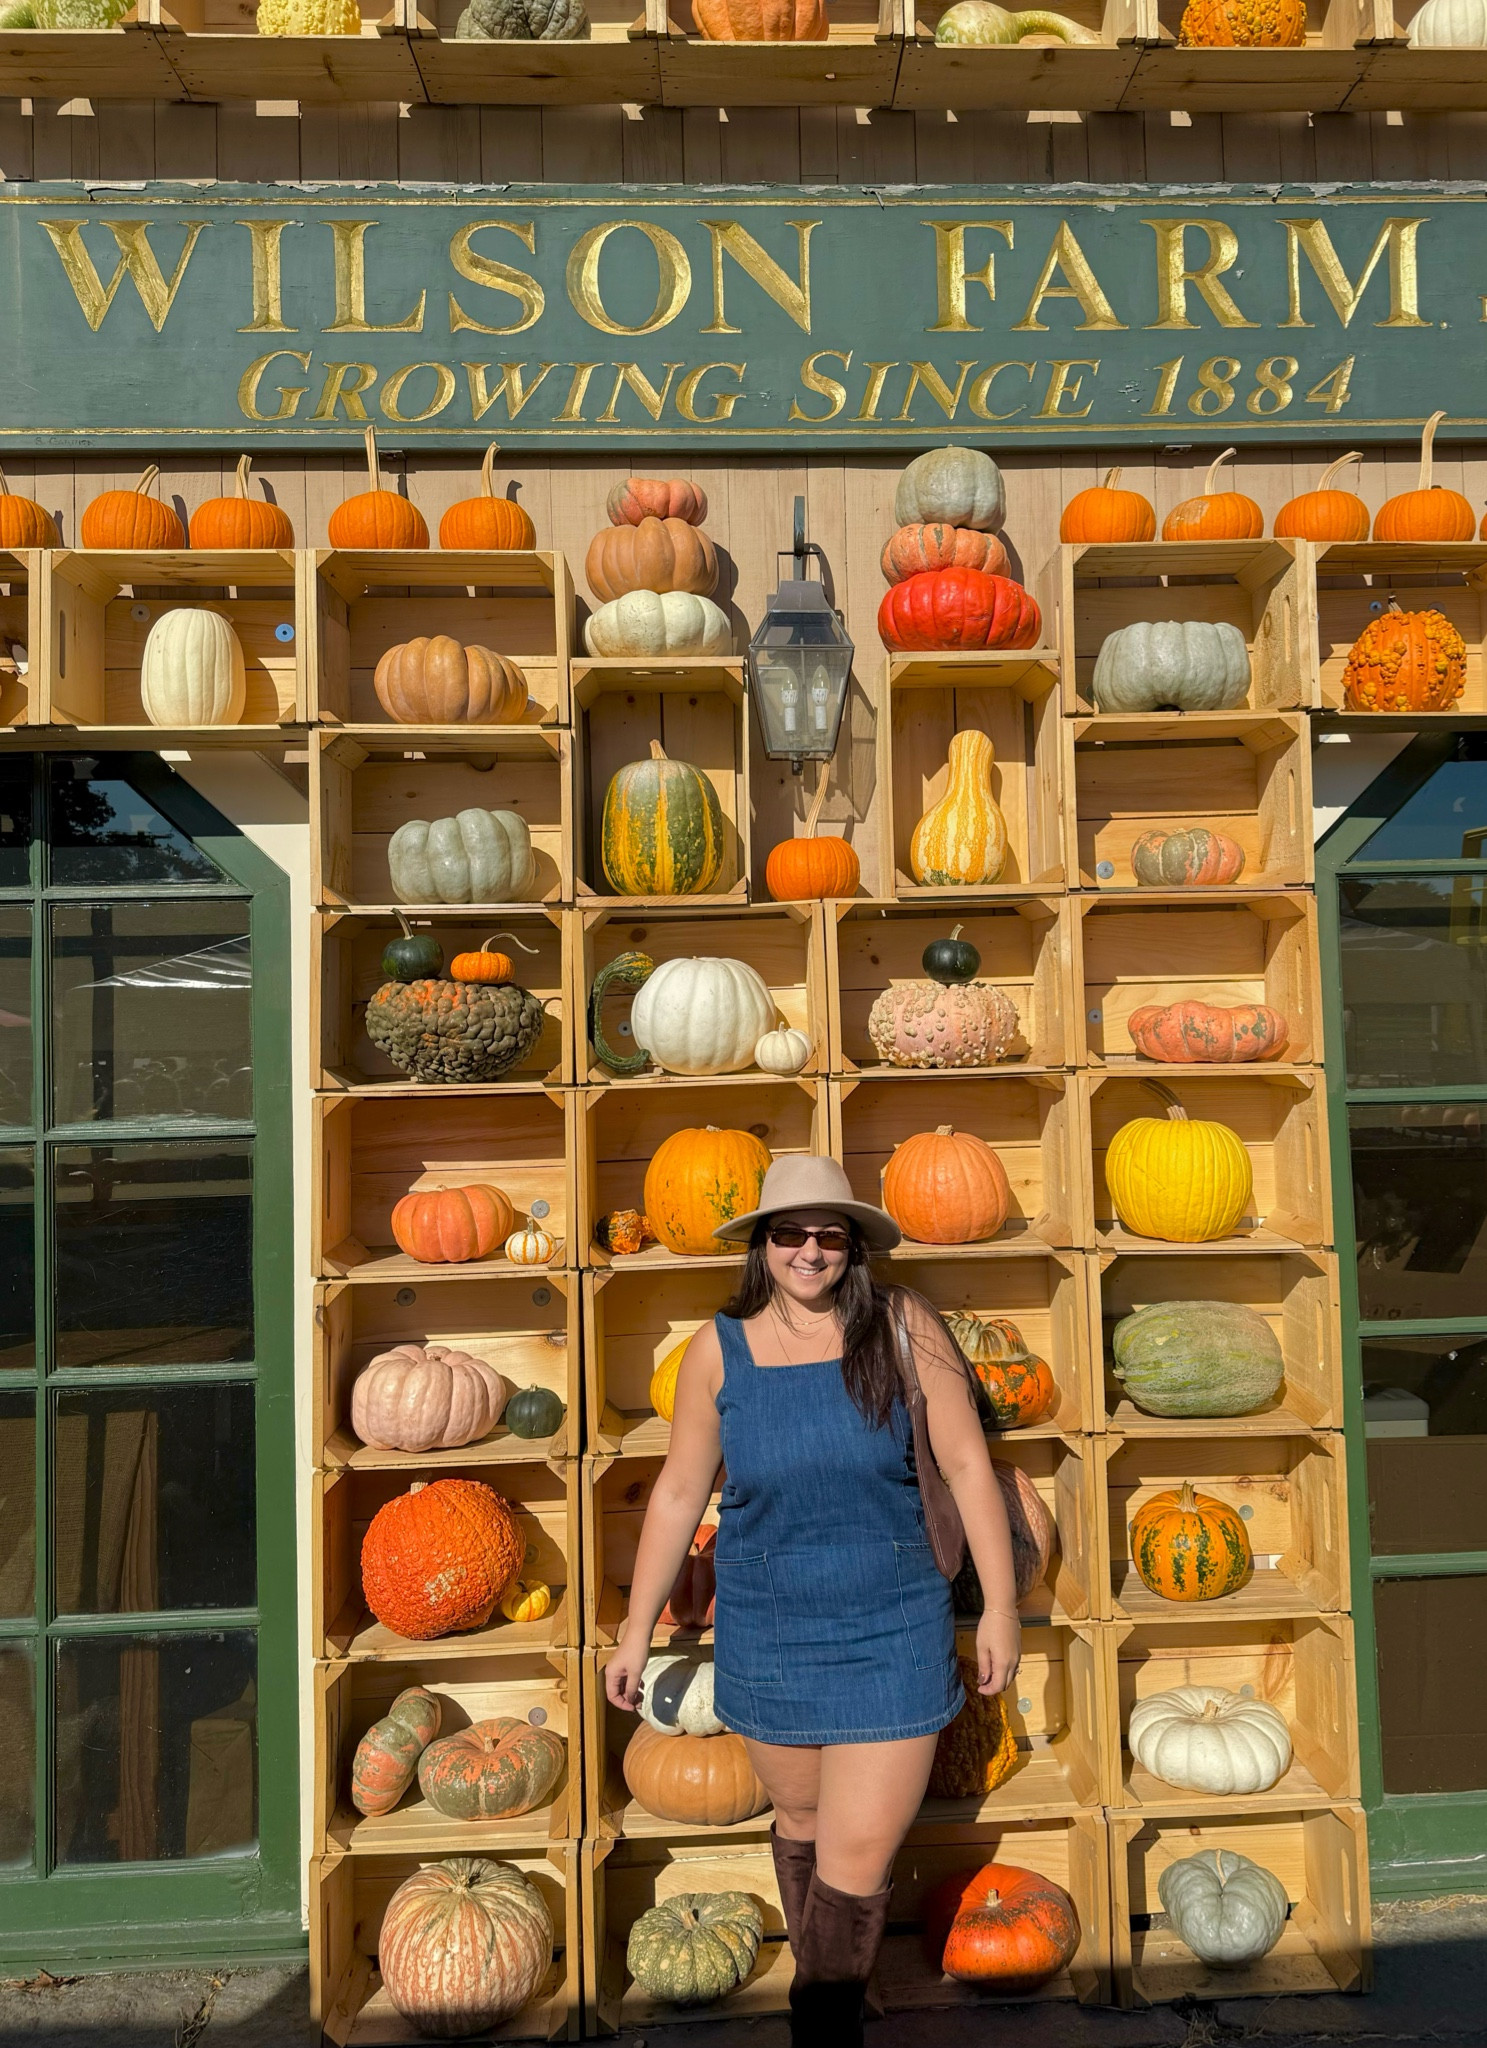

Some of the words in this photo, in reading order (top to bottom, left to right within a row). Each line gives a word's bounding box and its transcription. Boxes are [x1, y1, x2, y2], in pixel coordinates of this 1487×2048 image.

[37, 218, 823, 336] WILSON
[237, 349, 747, 424] GROWING
[788, 349, 1101, 423] SINCE
[1141, 353, 1355, 416] 1884
